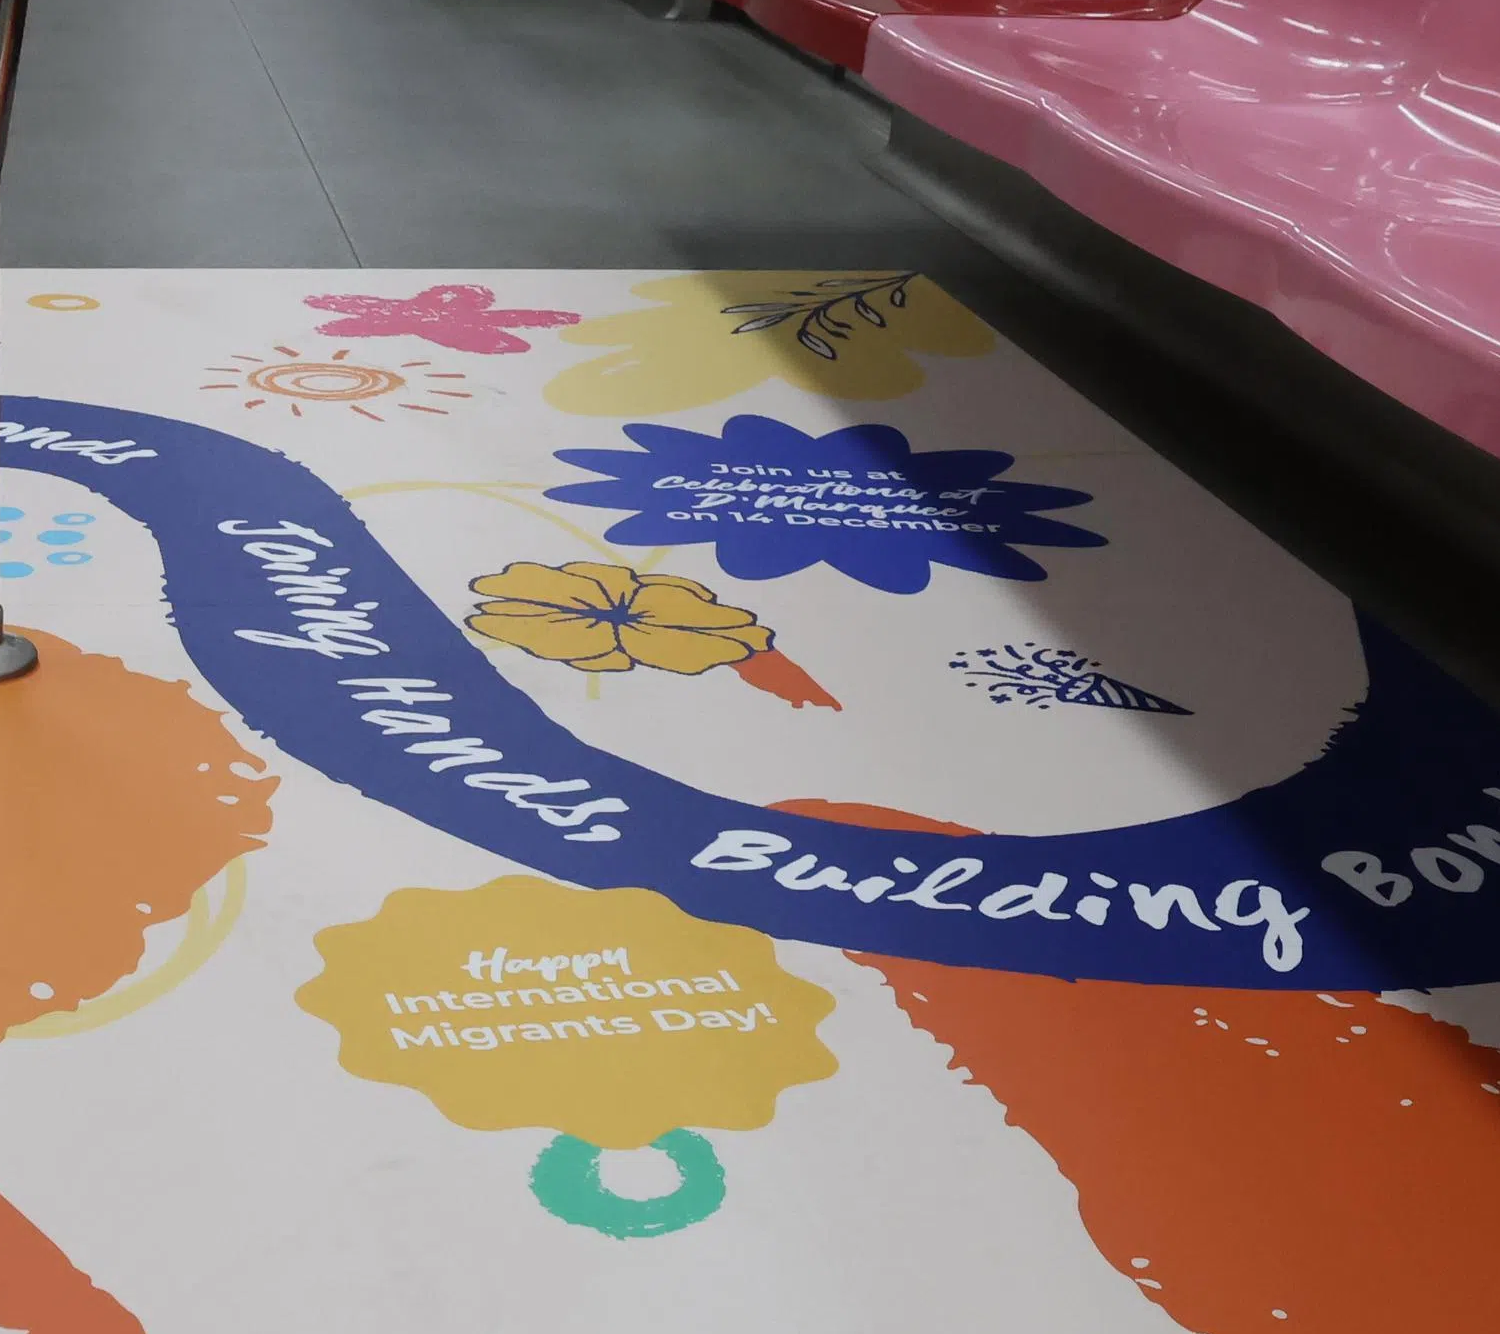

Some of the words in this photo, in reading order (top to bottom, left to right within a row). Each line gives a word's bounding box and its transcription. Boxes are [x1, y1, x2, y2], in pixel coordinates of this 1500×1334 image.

[652, 475, 930, 501] Celebrations
[939, 487, 1006, 505] at
[711, 463, 793, 478] Join
[807, 468, 853, 479] us
[867, 469, 907, 481] at
[666, 511, 719, 523] on
[729, 511, 773, 524] 14
[785, 514, 1002, 534] December
[217, 520, 390, 659] Joining
[337, 677, 630, 842] Hands,
[690, 828, 1311, 973] Building
[460, 947, 632, 983] Happy
[384, 970, 741, 1016] International
[390, 1011, 642, 1051] Migrants
[649, 1003, 779, 1034] Day!
